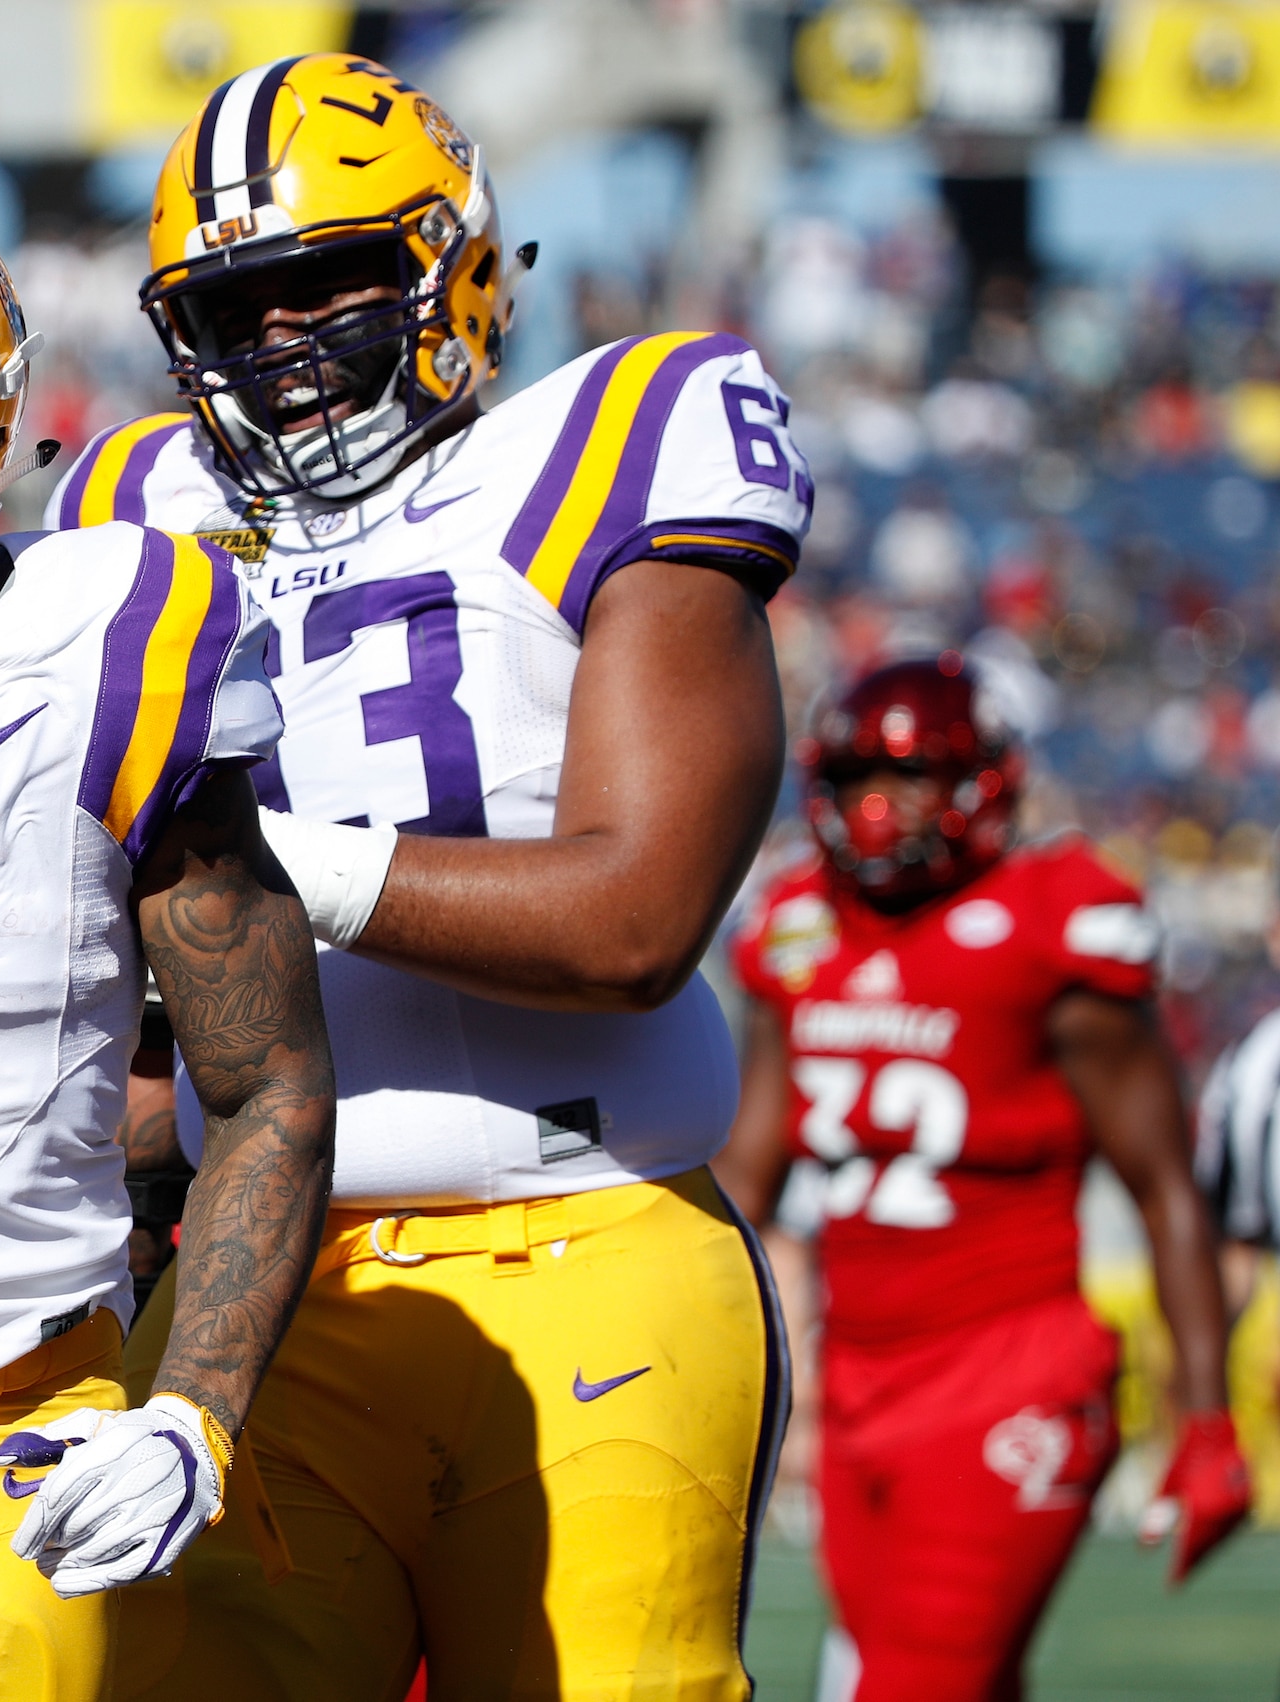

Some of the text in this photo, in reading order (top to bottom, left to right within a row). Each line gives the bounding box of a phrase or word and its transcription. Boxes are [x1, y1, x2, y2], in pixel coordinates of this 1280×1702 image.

[201, 212, 258, 251] LSU
[271, 560, 347, 599] LSU
[256, 570, 489, 837] 3
[791, 1055, 970, 1230] 32
